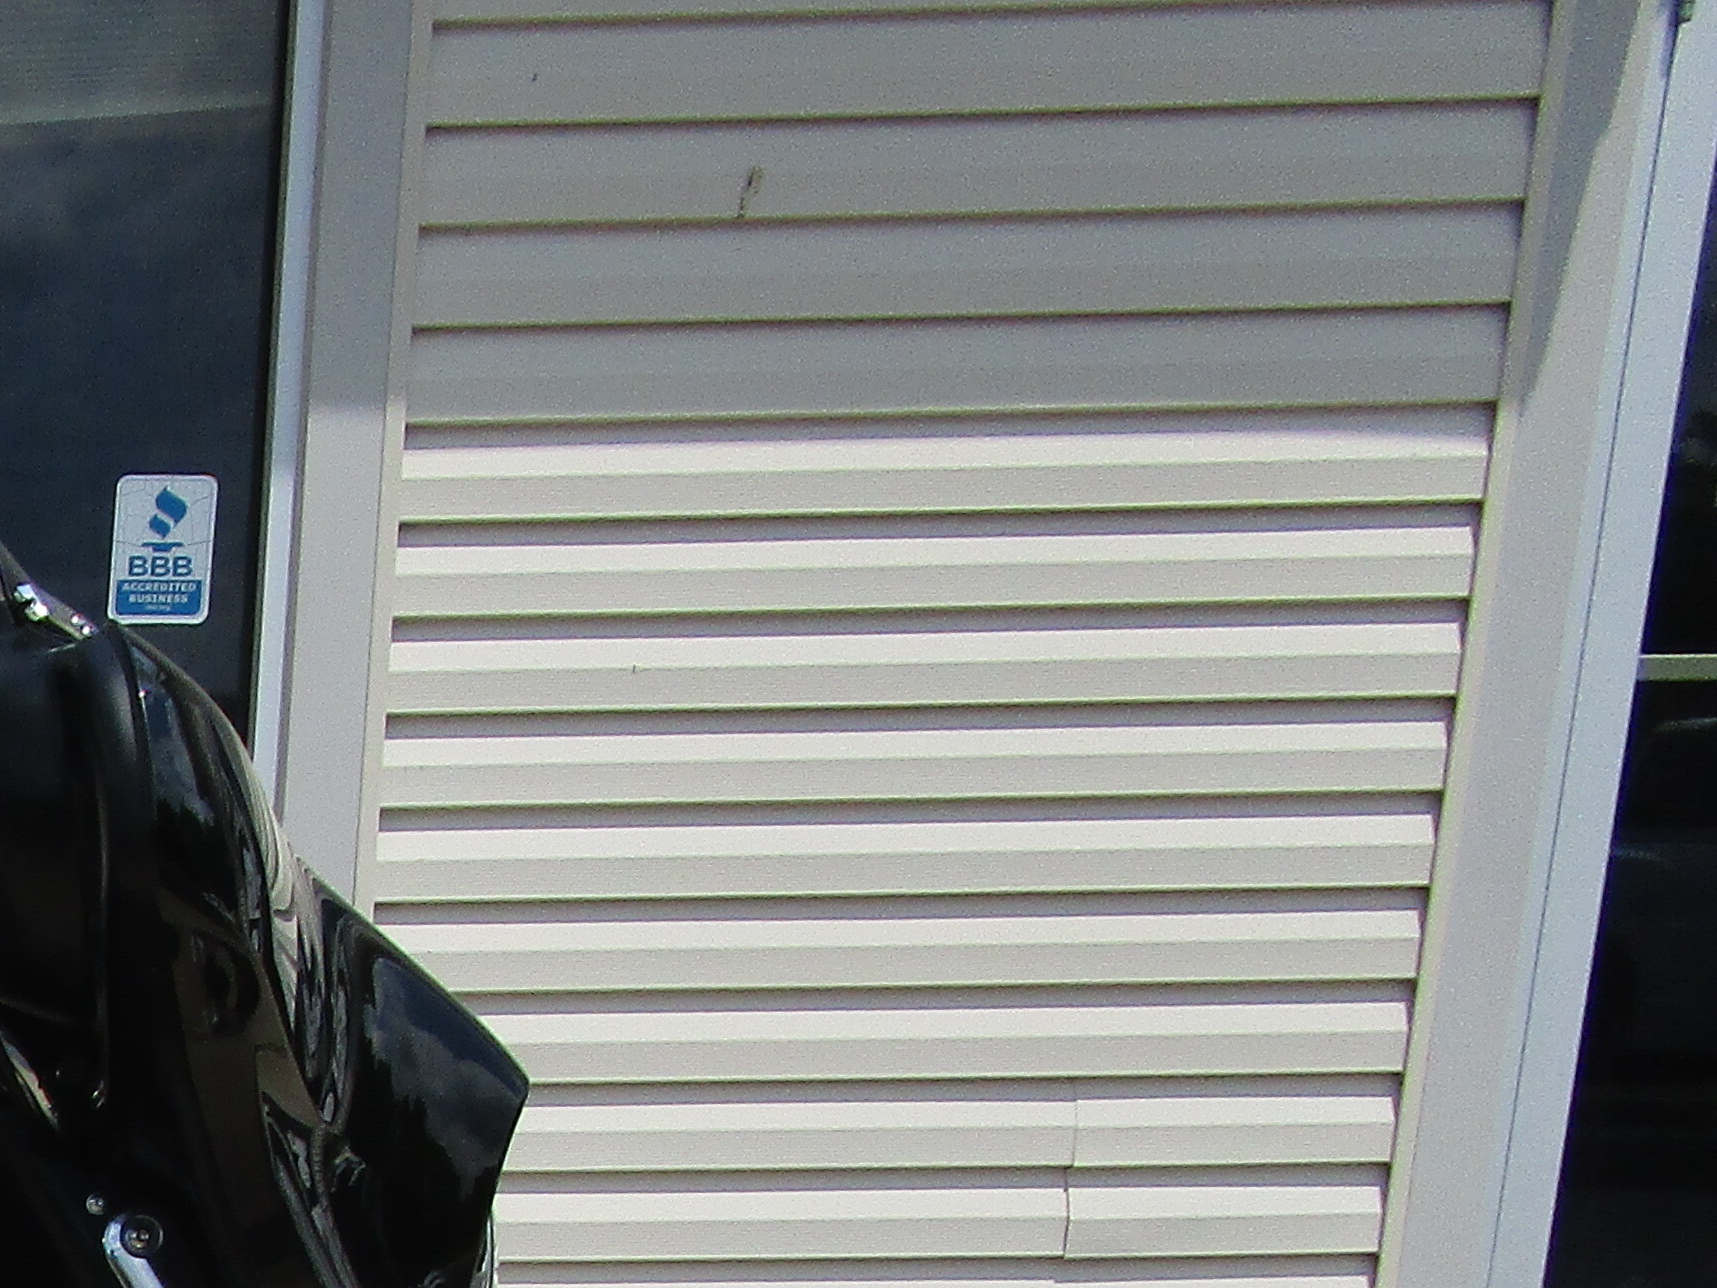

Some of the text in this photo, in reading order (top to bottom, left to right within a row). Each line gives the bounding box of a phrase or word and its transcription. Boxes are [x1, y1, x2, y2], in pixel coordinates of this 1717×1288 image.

[128, 555, 194, 576] BBB
[122, 582, 197, 592] ACCREDITED
[128, 593, 189, 603] BUSINESS
